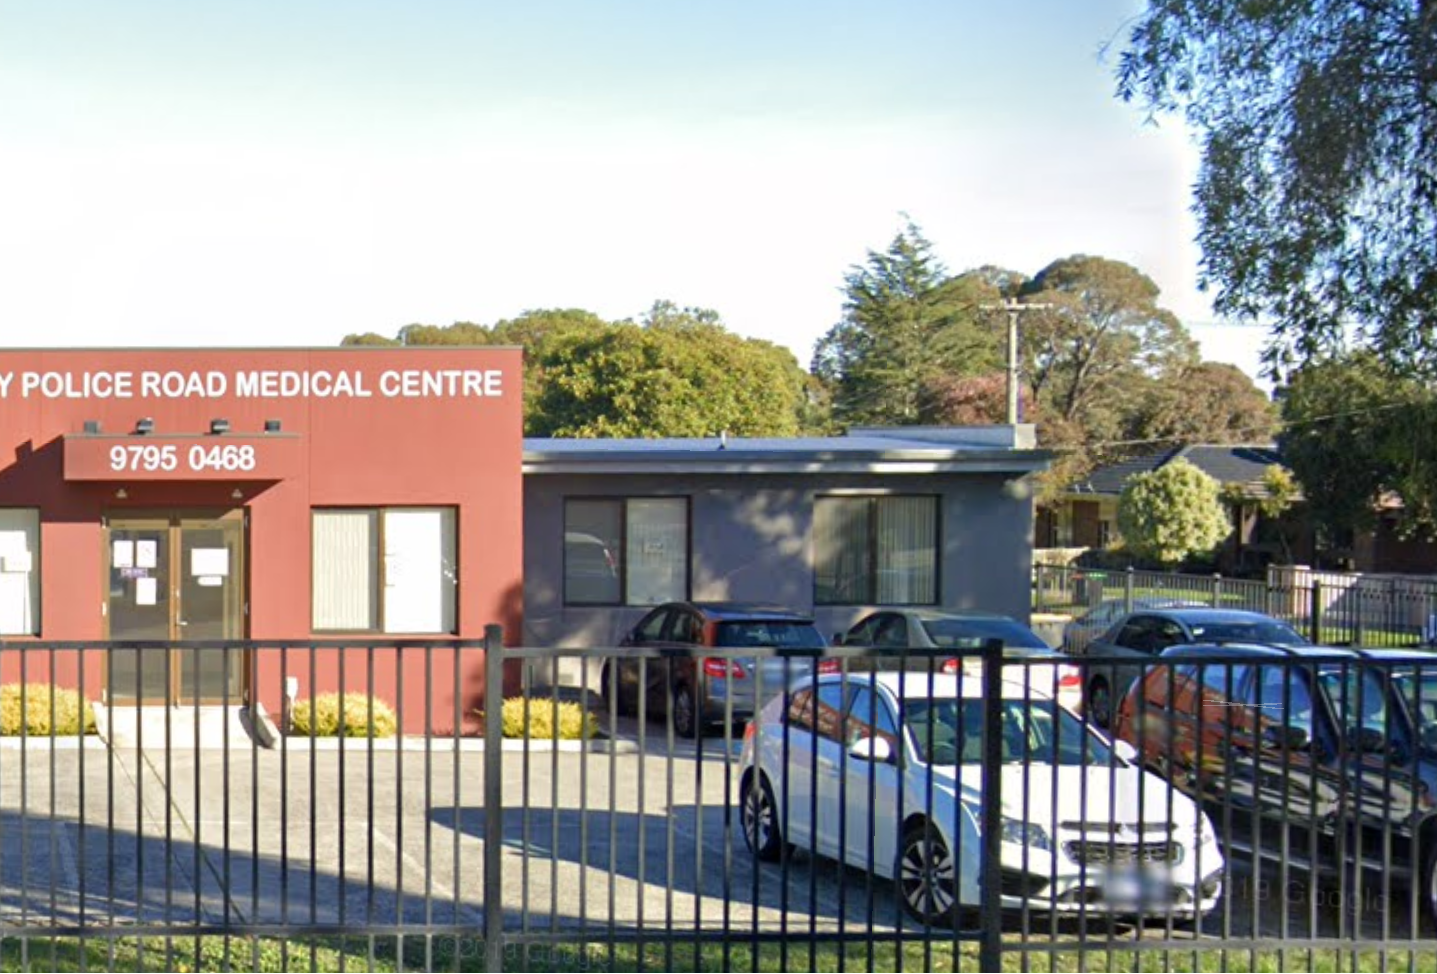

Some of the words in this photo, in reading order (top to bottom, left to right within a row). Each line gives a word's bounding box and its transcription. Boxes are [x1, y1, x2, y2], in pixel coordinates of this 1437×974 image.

[22, 371, 133, 398] POLICE
[141, 371, 227, 397] ROAD
[236, 370, 372, 397] MEDICAL
[379, 369, 503, 397] CENTRE
[109, 445, 178, 471] 9795
[188, 444, 256, 471] 0468
